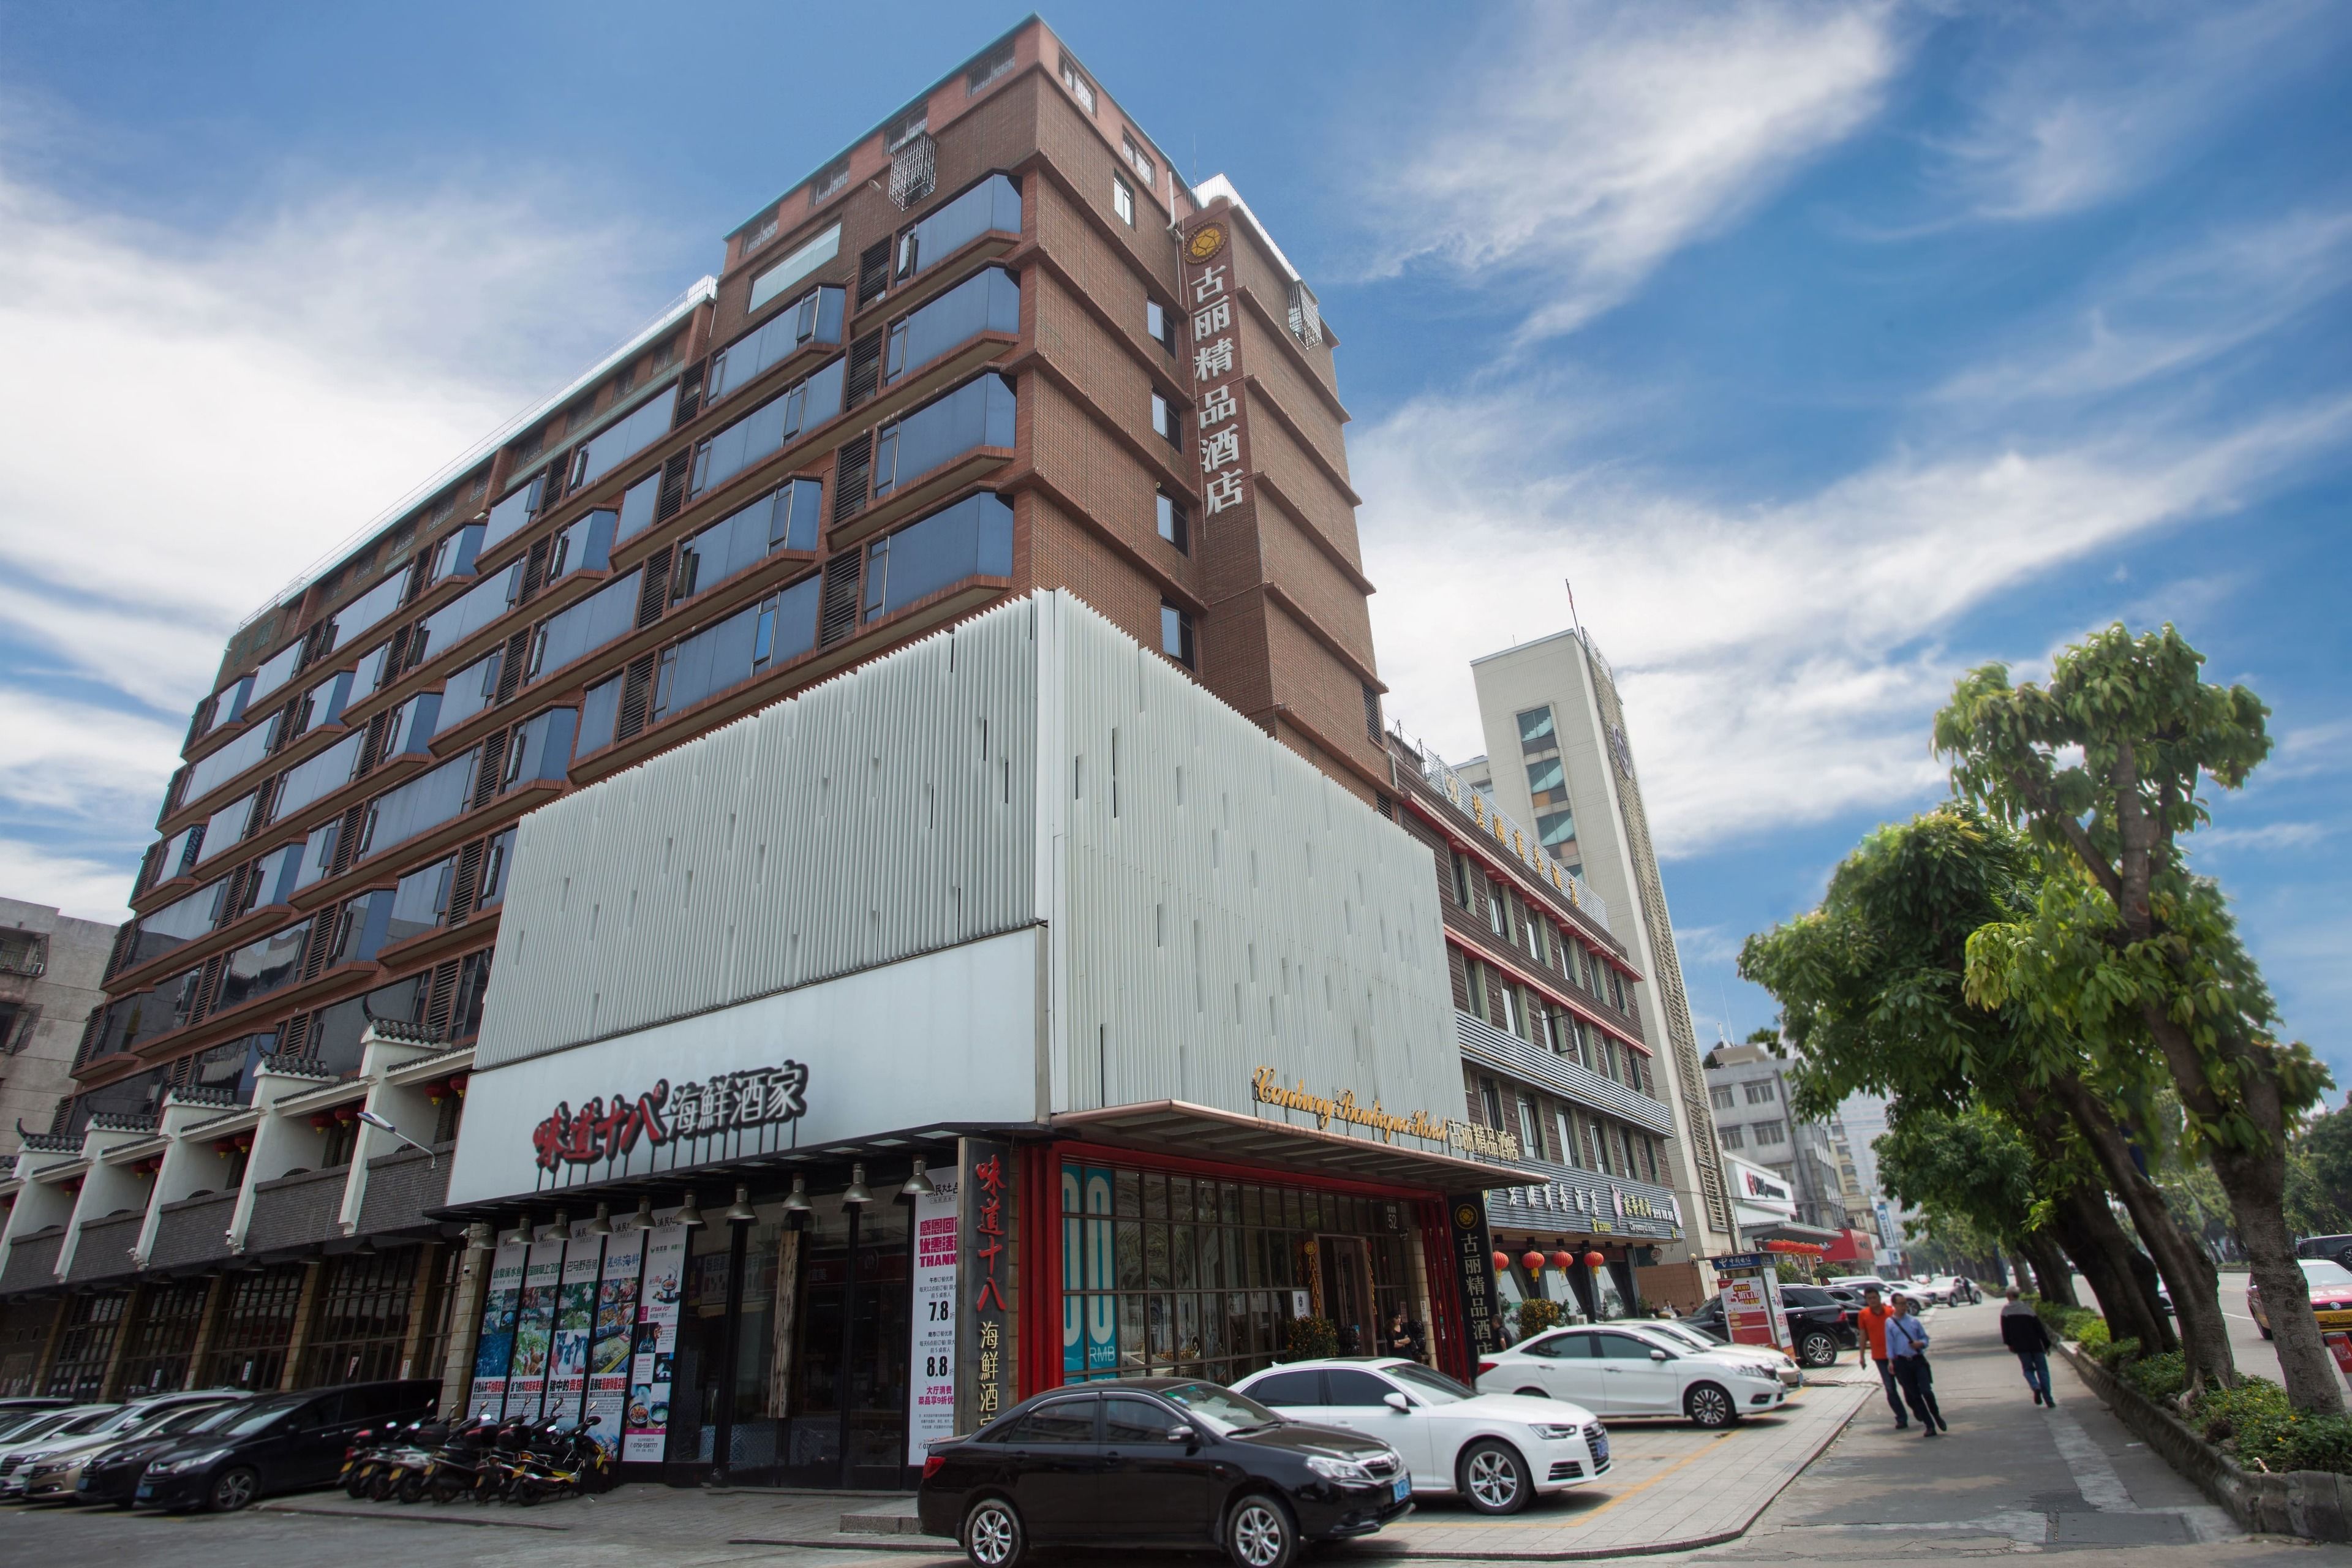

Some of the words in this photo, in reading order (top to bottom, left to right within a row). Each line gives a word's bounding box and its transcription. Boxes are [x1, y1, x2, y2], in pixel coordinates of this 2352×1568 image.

[1190, 265, 1244, 519] 古丽精品酒店
[1253, 1065, 1334, 1131] Century
[1334, 1087, 1409, 1144] Boutique
[1410, 1109, 1449, 1142] Hotel
[532, 1084, 668, 1171] 味道十八
[1448, 1117, 1519, 1162] 古丽精品酒店
[919, 1216, 958, 1237] 感恩回
[1388, 1214, 1398, 1229] 52
[919, 1234, 957, 1254] 优惠活
[976, 1154, 1007, 1313] 味道十八
[929, 1300, 949, 1322] 7.8
[1089, 1346, 1115, 1363] RMB
[927, 1355, 948, 1378] 8.8
[927, 1385, 952, 1395] 大厅消费
